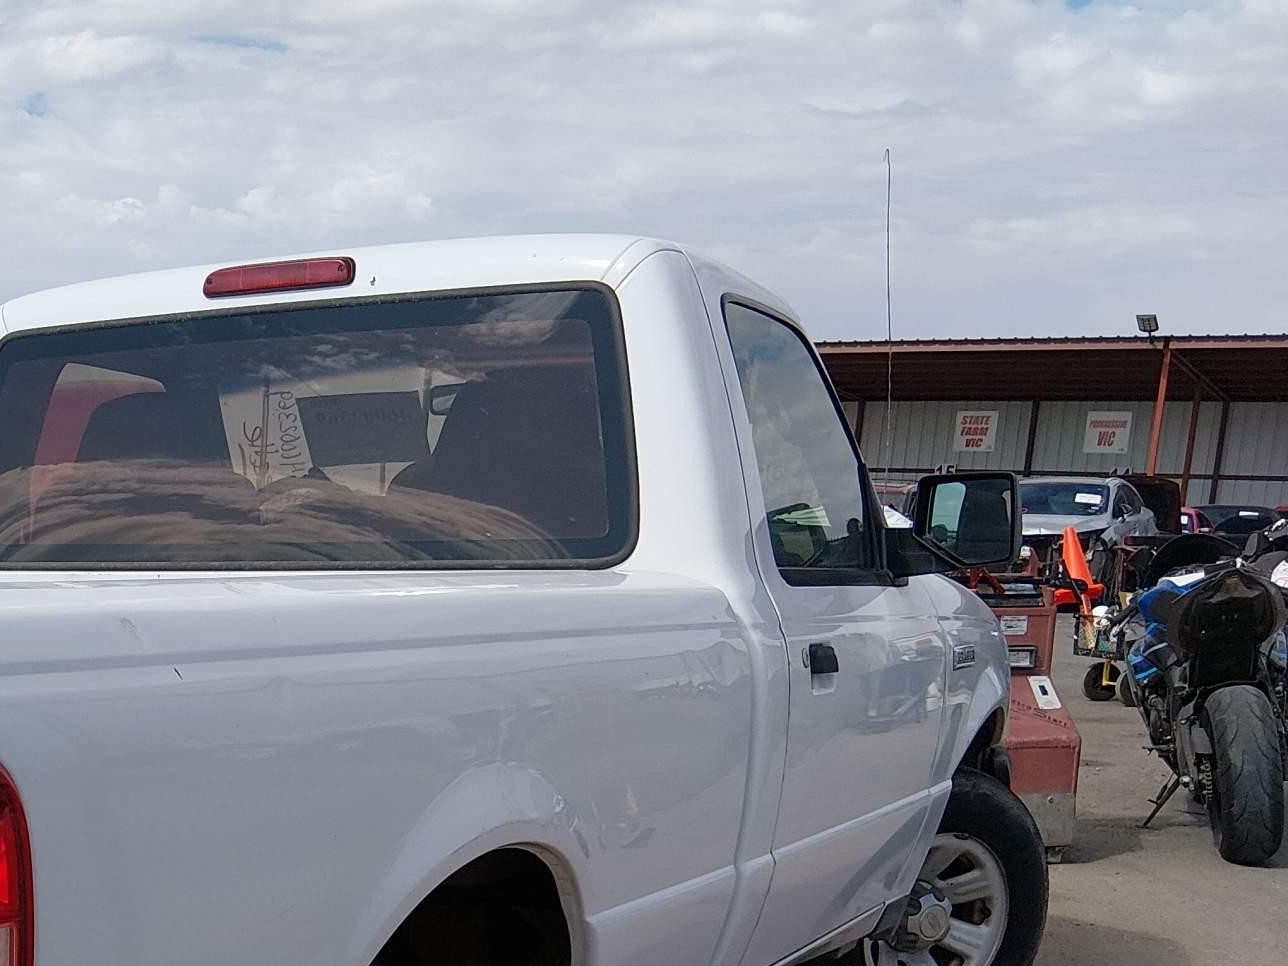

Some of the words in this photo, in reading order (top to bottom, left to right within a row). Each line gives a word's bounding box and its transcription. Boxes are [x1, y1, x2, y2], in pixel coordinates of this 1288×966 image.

[960, 416, 991, 426] STATE
[959, 427, 989, 436] FARM
[964, 437, 983, 448] VIC
[1097, 430, 1116, 447] VIC
